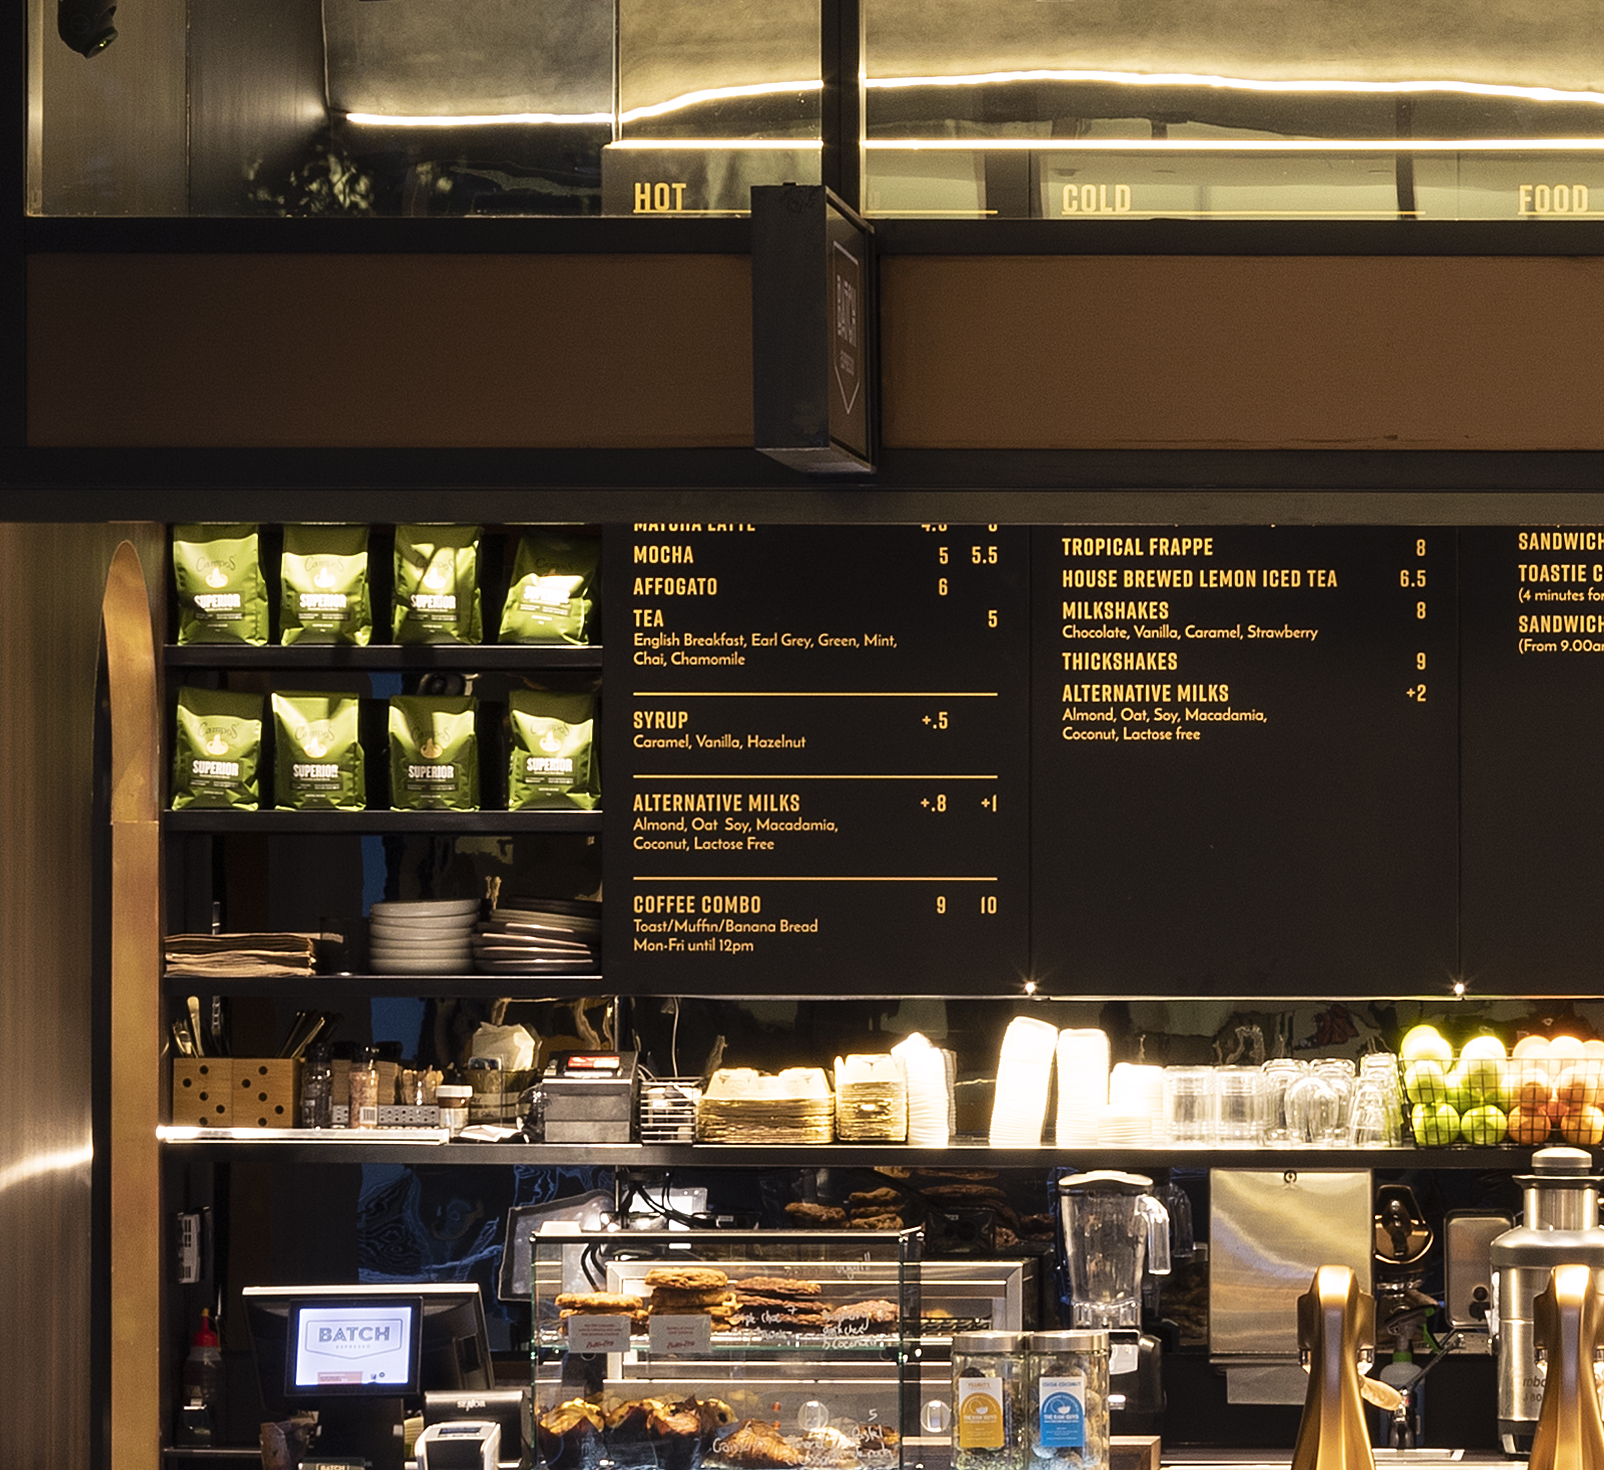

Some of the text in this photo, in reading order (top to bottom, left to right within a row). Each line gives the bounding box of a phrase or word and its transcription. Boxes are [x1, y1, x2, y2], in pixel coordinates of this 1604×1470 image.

[634, 182, 687, 212] HOT
[1062, 184, 1131, 213] COLD
[1519, 184, 1589, 213] FOOD
[634, 546, 997, 564] MOCHA 5 5.5
[1062, 538, 1425, 556] TROPICAL FRAPPE 8
[1063, 570, 1425, 587] HOUSE BREWED LEMON ICED TEA 6.5
[1519, 565, 1586, 582] TOASTIE
[633, 578, 947, 595] AFFOGATO 6
[300, 593, 347, 608] SUPERIOR
[1519, 588, 1531, 603] (4
[1535, 590, 1584, 601] minutes
[633, 610, 997, 627] TEA 5
[1063, 602, 1426, 619] MILKSHAKES 8
[634, 632, 897, 649] English Breakfast, Earl Grey, Green, Mint,
[1063, 624, 1318, 641] Chocolate, Vanilla, Caramel, Strawberry
[1519, 639, 1557, 654] (From
[634, 651, 745, 666] Chai, Chamomile
[1062, 652, 1425, 670] THICKSHAKES 9
[1062, 684, 1426, 702] ALTERNATIVE MILKS +2
[634, 711, 947, 729] SYRUP +.5
[1062, 707, 1267, 724] Almond, Oat, Soy, Macadamia,
[634, 734, 805, 749] Caramel, Vanilla, Hazelnut
[1063, 726, 1200, 741] Coconut, Lactose free
[192, 760, 239, 776] SUPERIOR
[293, 764, 339, 778] SUPERIOR
[408, 764, 454, 779] SUPERIOR
[527, 757, 573, 772] SUPERIOR
[633, 794, 742, 811] ALTERNATIVE
[749, 794, 799, 811] MILKS
[921, 794, 946, 812] +.8
[633, 817, 838, 833] Almond, Oat Soy, Macadamia,
[634, 837, 774, 851] Coconut, Lactose Free
[634, 896, 996, 914] COFFEE COMBO 9 10
[634, 918, 818, 932] Toast/Muffin/Banana Bread
[688, 938, 715, 951] until
[720, 939, 753, 954] 12pm
[318, 1326, 390, 1342] BATCH
